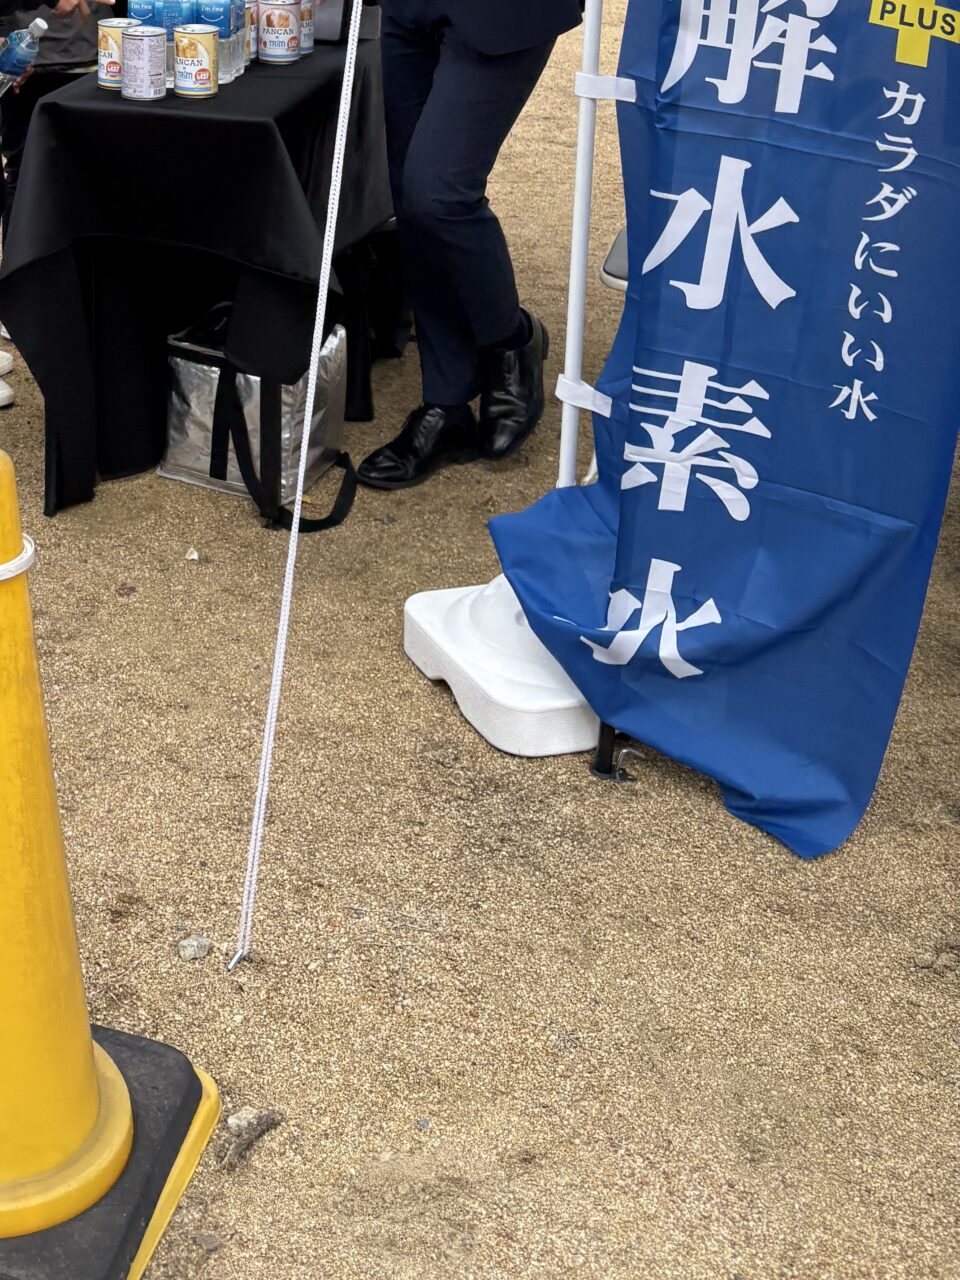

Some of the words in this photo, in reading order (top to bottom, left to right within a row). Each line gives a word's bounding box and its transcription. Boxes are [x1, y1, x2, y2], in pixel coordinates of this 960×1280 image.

[880, 0, 956, 36] PLUS
[828, 80, 927, 422] カラダにいい水
